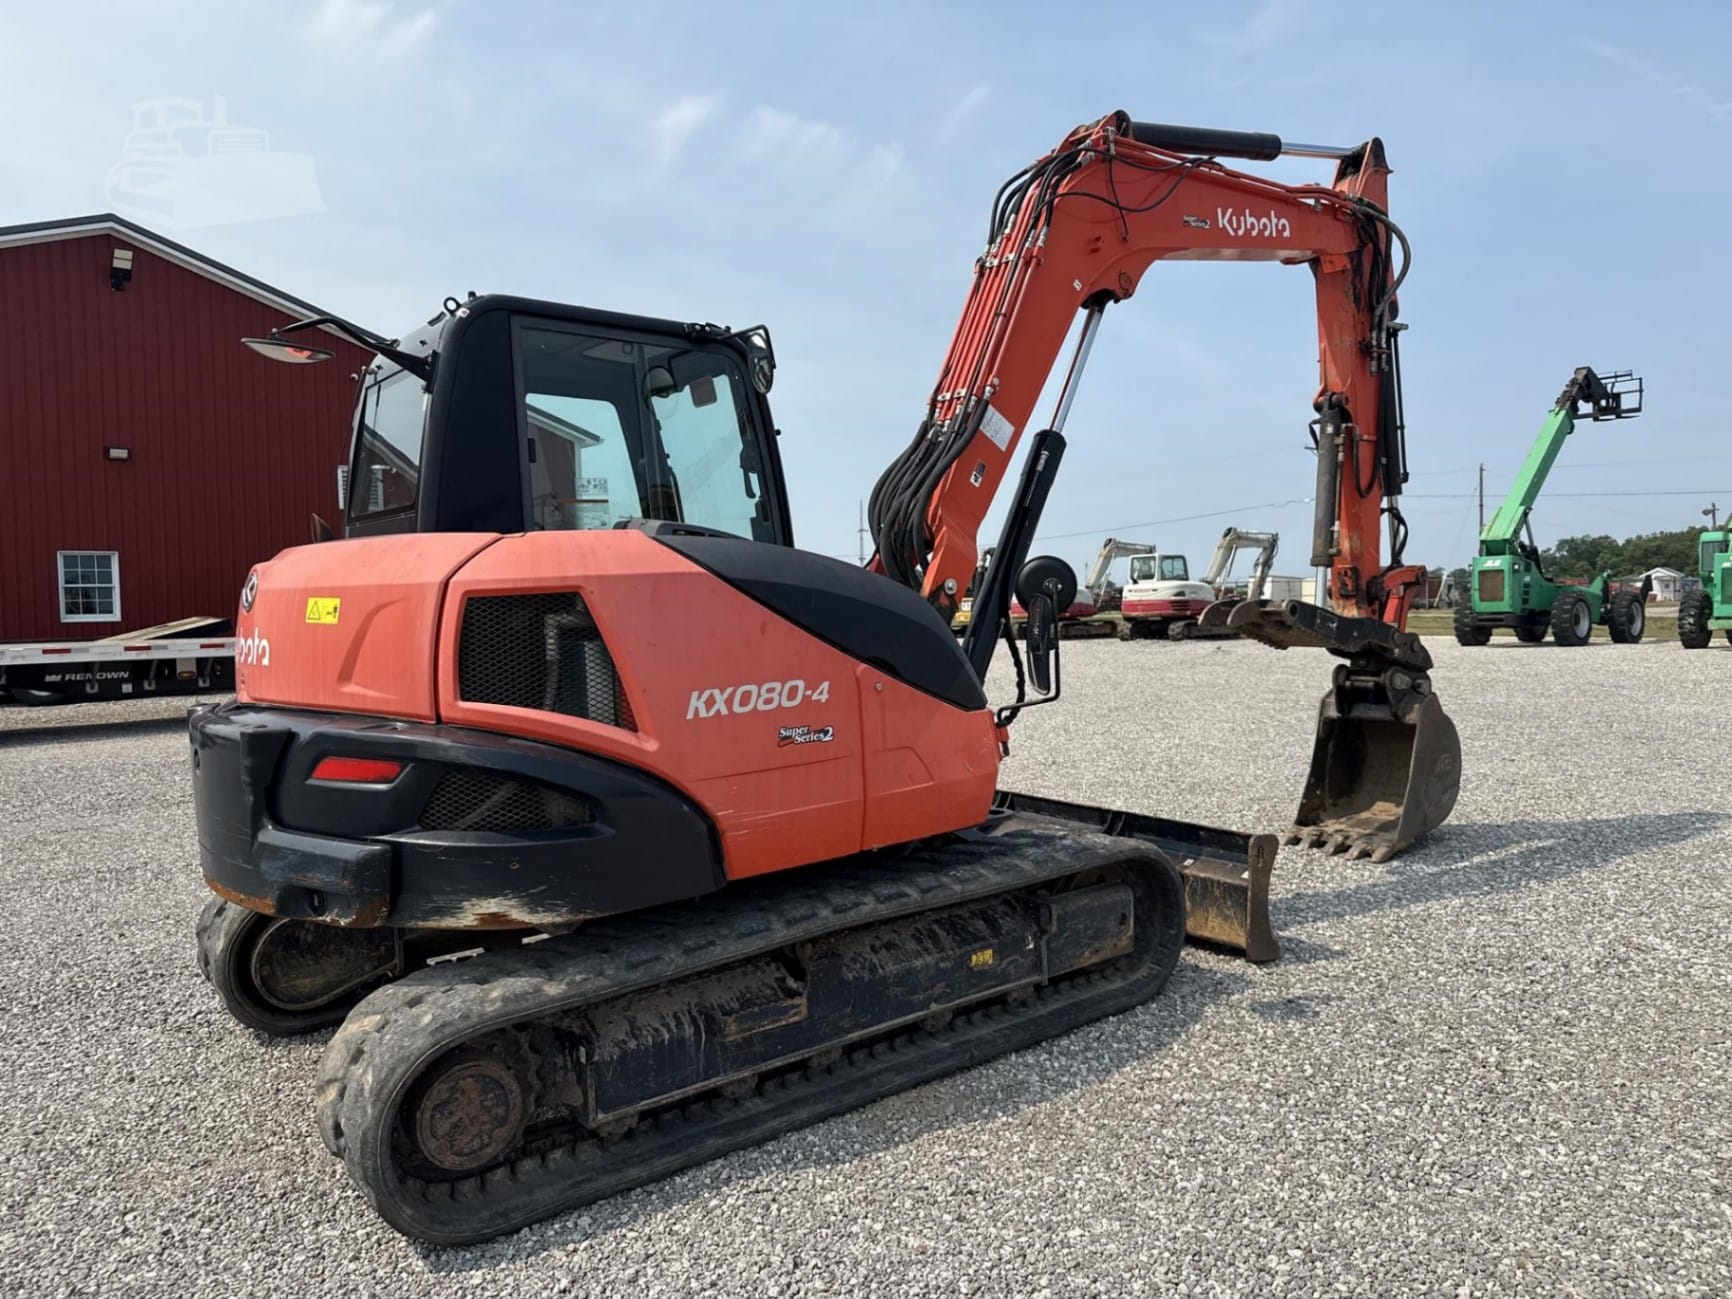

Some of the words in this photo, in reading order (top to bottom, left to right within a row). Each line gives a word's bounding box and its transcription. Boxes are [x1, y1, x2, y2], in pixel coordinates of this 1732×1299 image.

[1217, 207, 1291, 237] Kubota
[64, 671, 130, 681] RENOWN
[686, 679, 831, 720] KX080-4
[779, 726, 810, 738] Super
